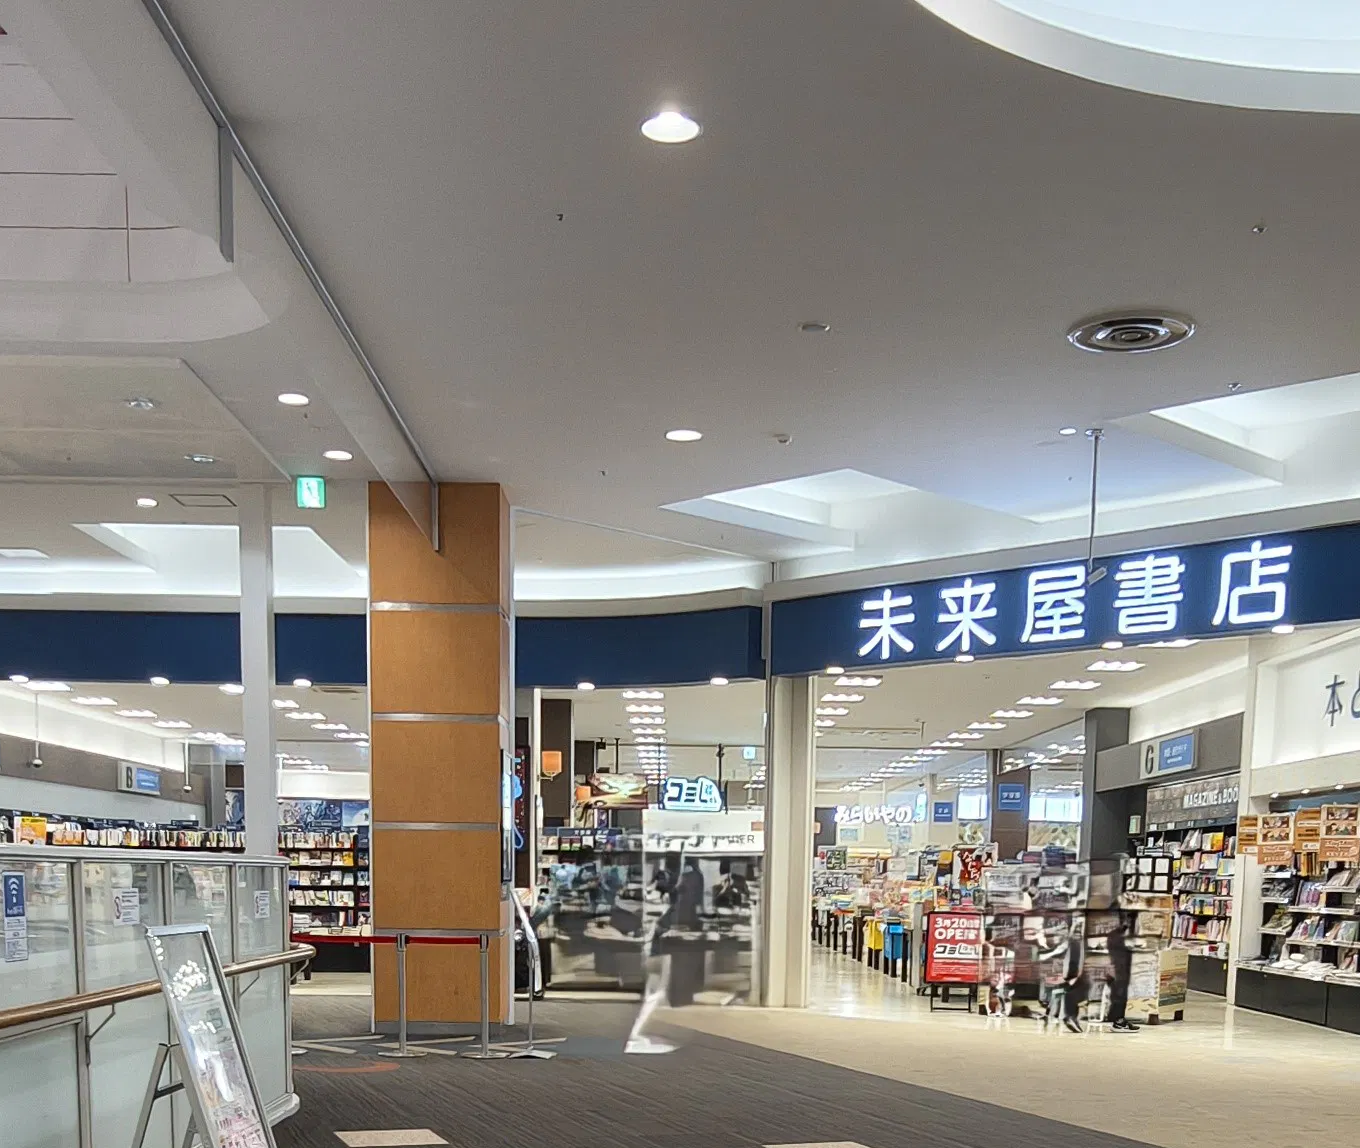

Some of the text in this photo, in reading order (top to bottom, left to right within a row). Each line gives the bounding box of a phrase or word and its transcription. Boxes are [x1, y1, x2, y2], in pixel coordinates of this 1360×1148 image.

[858, 540, 1293, 660] 未来屋書店
[1145, 744, 1154, 774] G
[126, 766, 133, 788] B
